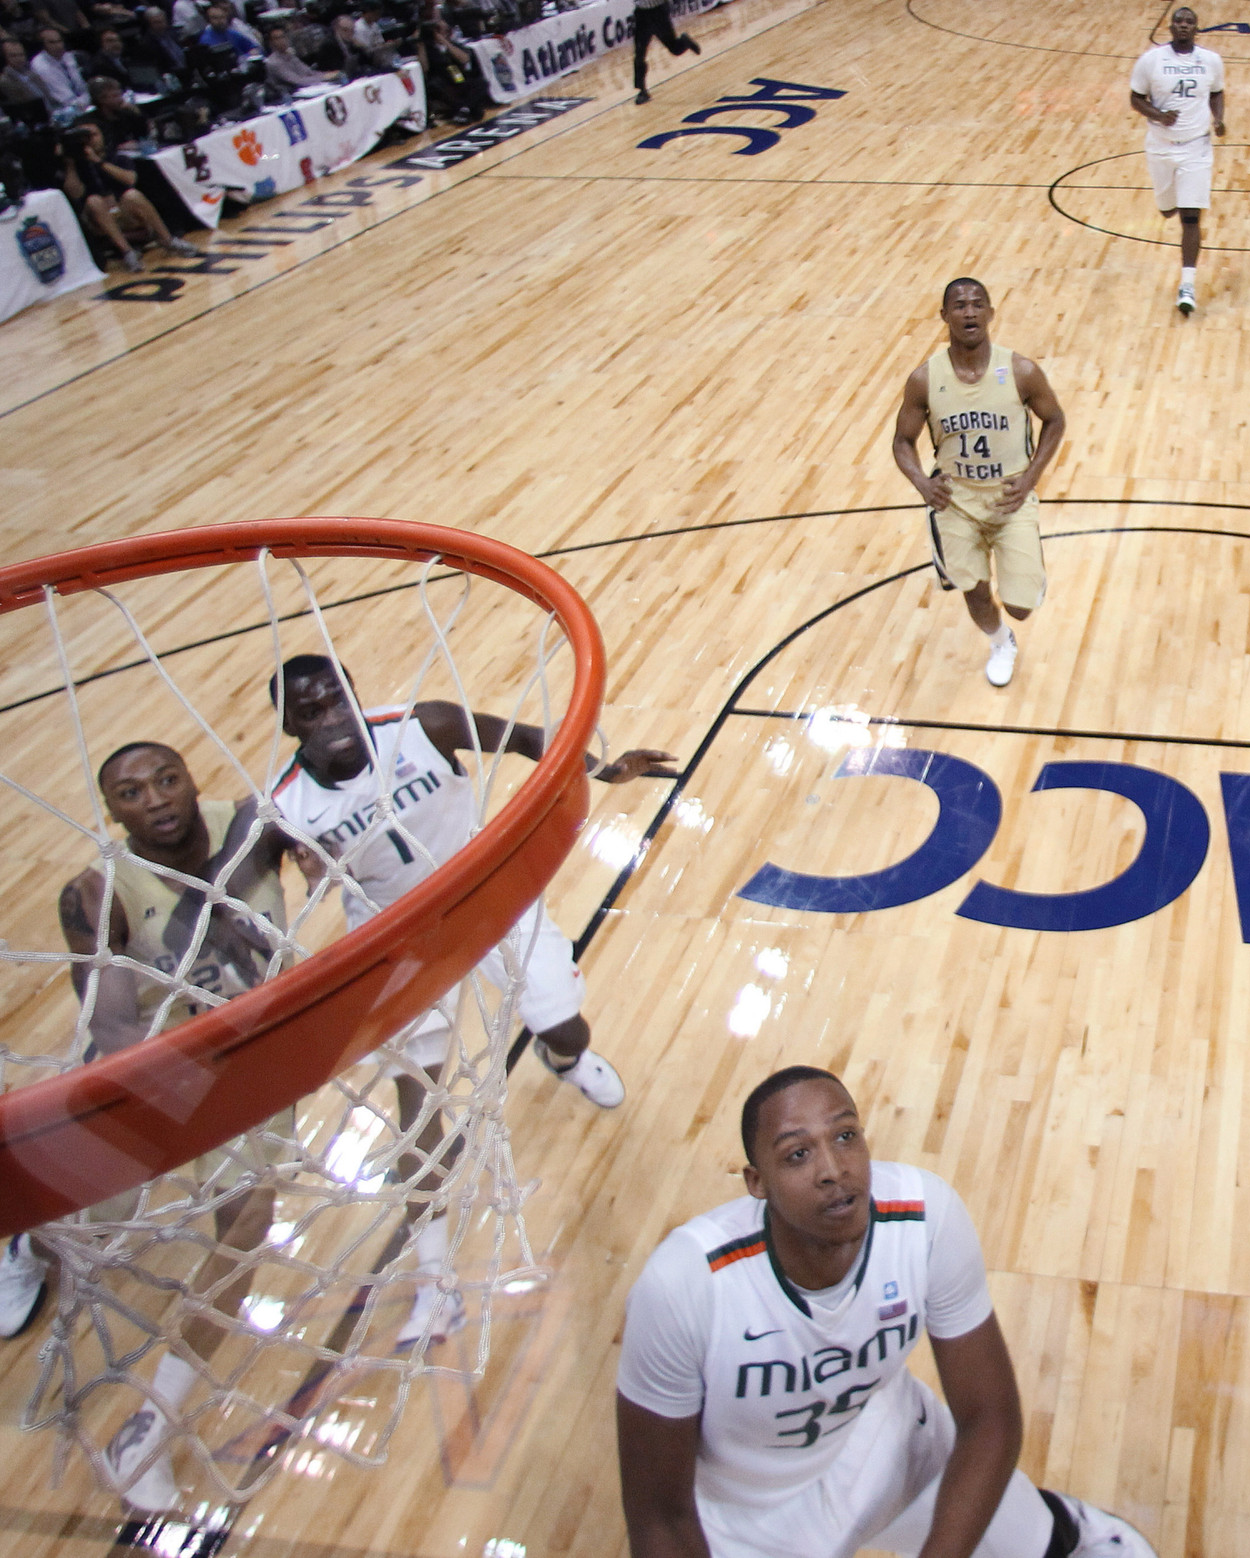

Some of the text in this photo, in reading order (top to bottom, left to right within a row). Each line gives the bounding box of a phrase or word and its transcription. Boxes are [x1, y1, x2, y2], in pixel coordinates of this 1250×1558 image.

[523, 16, 635, 85] Atlantic Coa
[1172, 79, 1198, 98] 42
[635, 77, 849, 156] ACC
[93, 98, 586, 302] PHILIPS ARENA
[940, 411, 1010, 434] GEORGIA
[959, 433, 991, 458] 14
[954, 461, 1003, 480] TECH
[386, 828, 415, 865] 1
